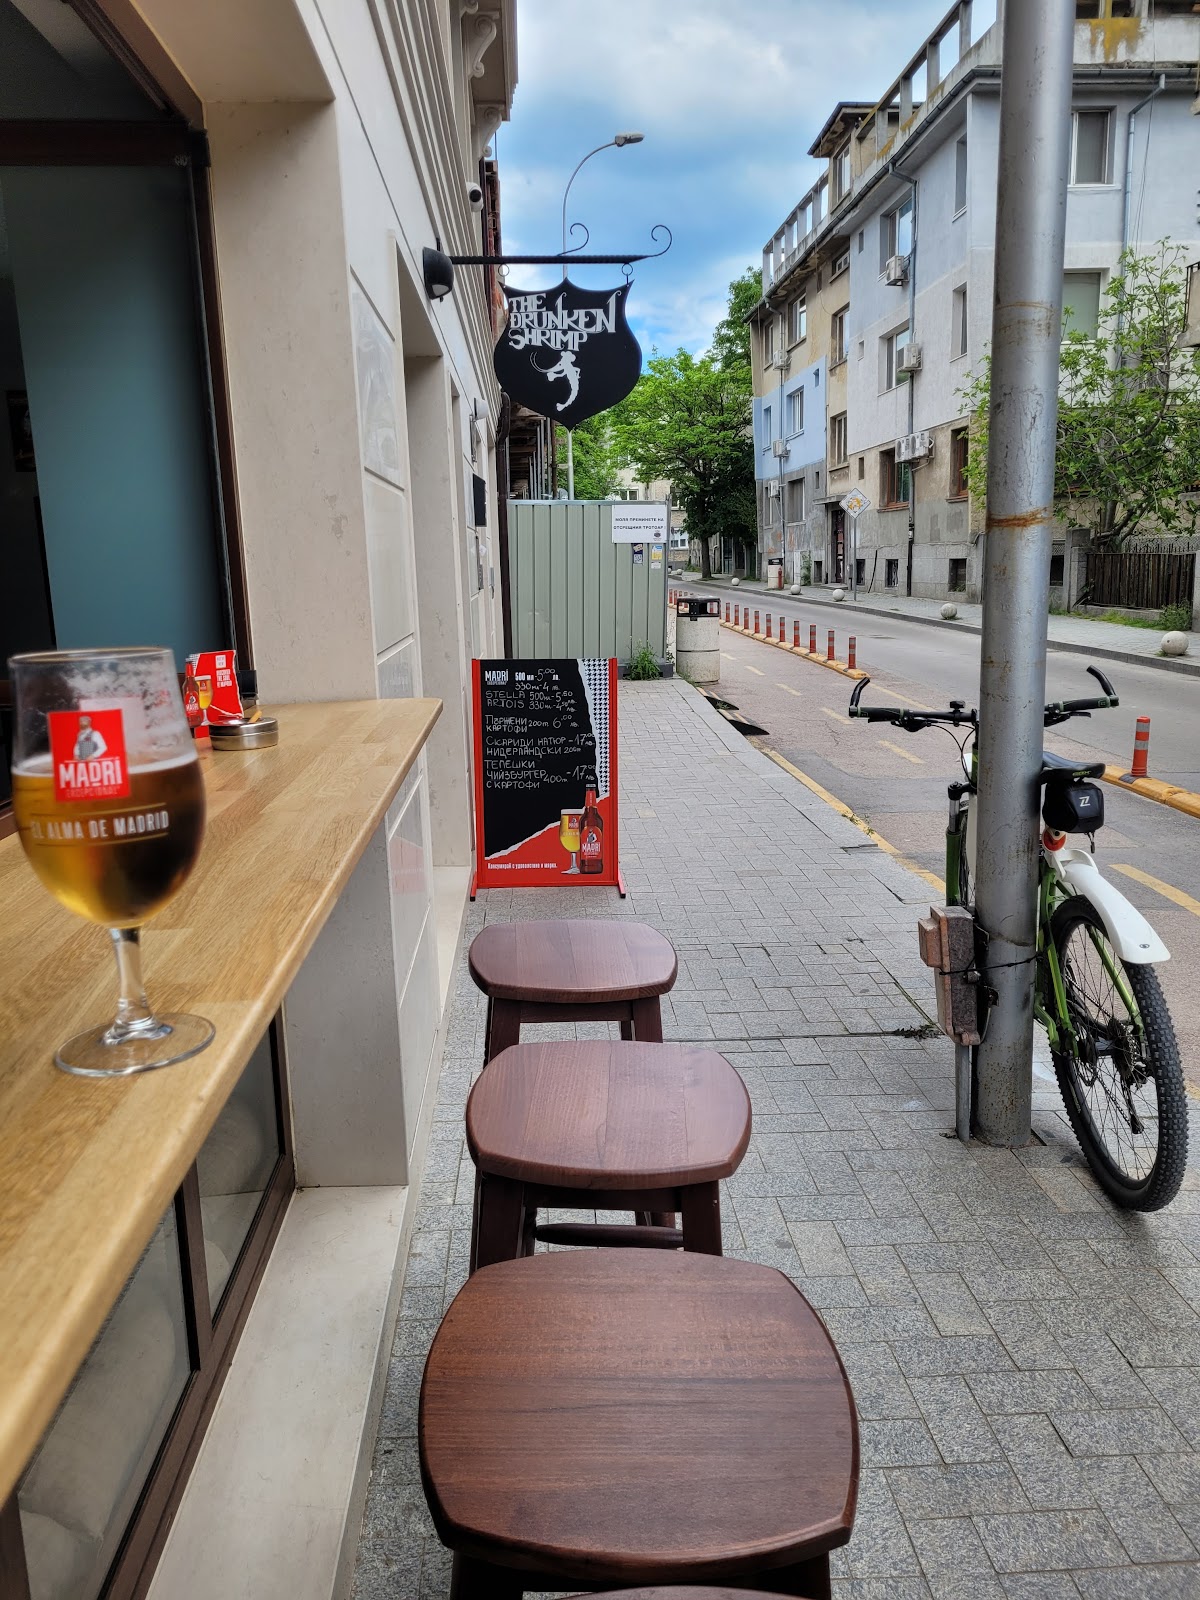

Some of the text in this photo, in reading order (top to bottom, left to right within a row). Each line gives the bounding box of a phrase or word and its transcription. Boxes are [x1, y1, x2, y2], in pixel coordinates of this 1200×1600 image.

[508, 293, 546, 313] THE
[510, 290, 621, 333] DRUNKEN
[508, 328, 588, 351] SHRIMP
[514, 671, 526, 681] 500
[485, 690, 526, 699] STELLA
[487, 699, 525, 709] ARTOIS
[486, 725, 528, 733] КАРТОФИ
[494, 781, 540, 790] КАРТОФИ
[47, 819, 84, 840] ALMA
[89, 820, 108, 838] DE
[113, 810, 169, 836] MADRID
